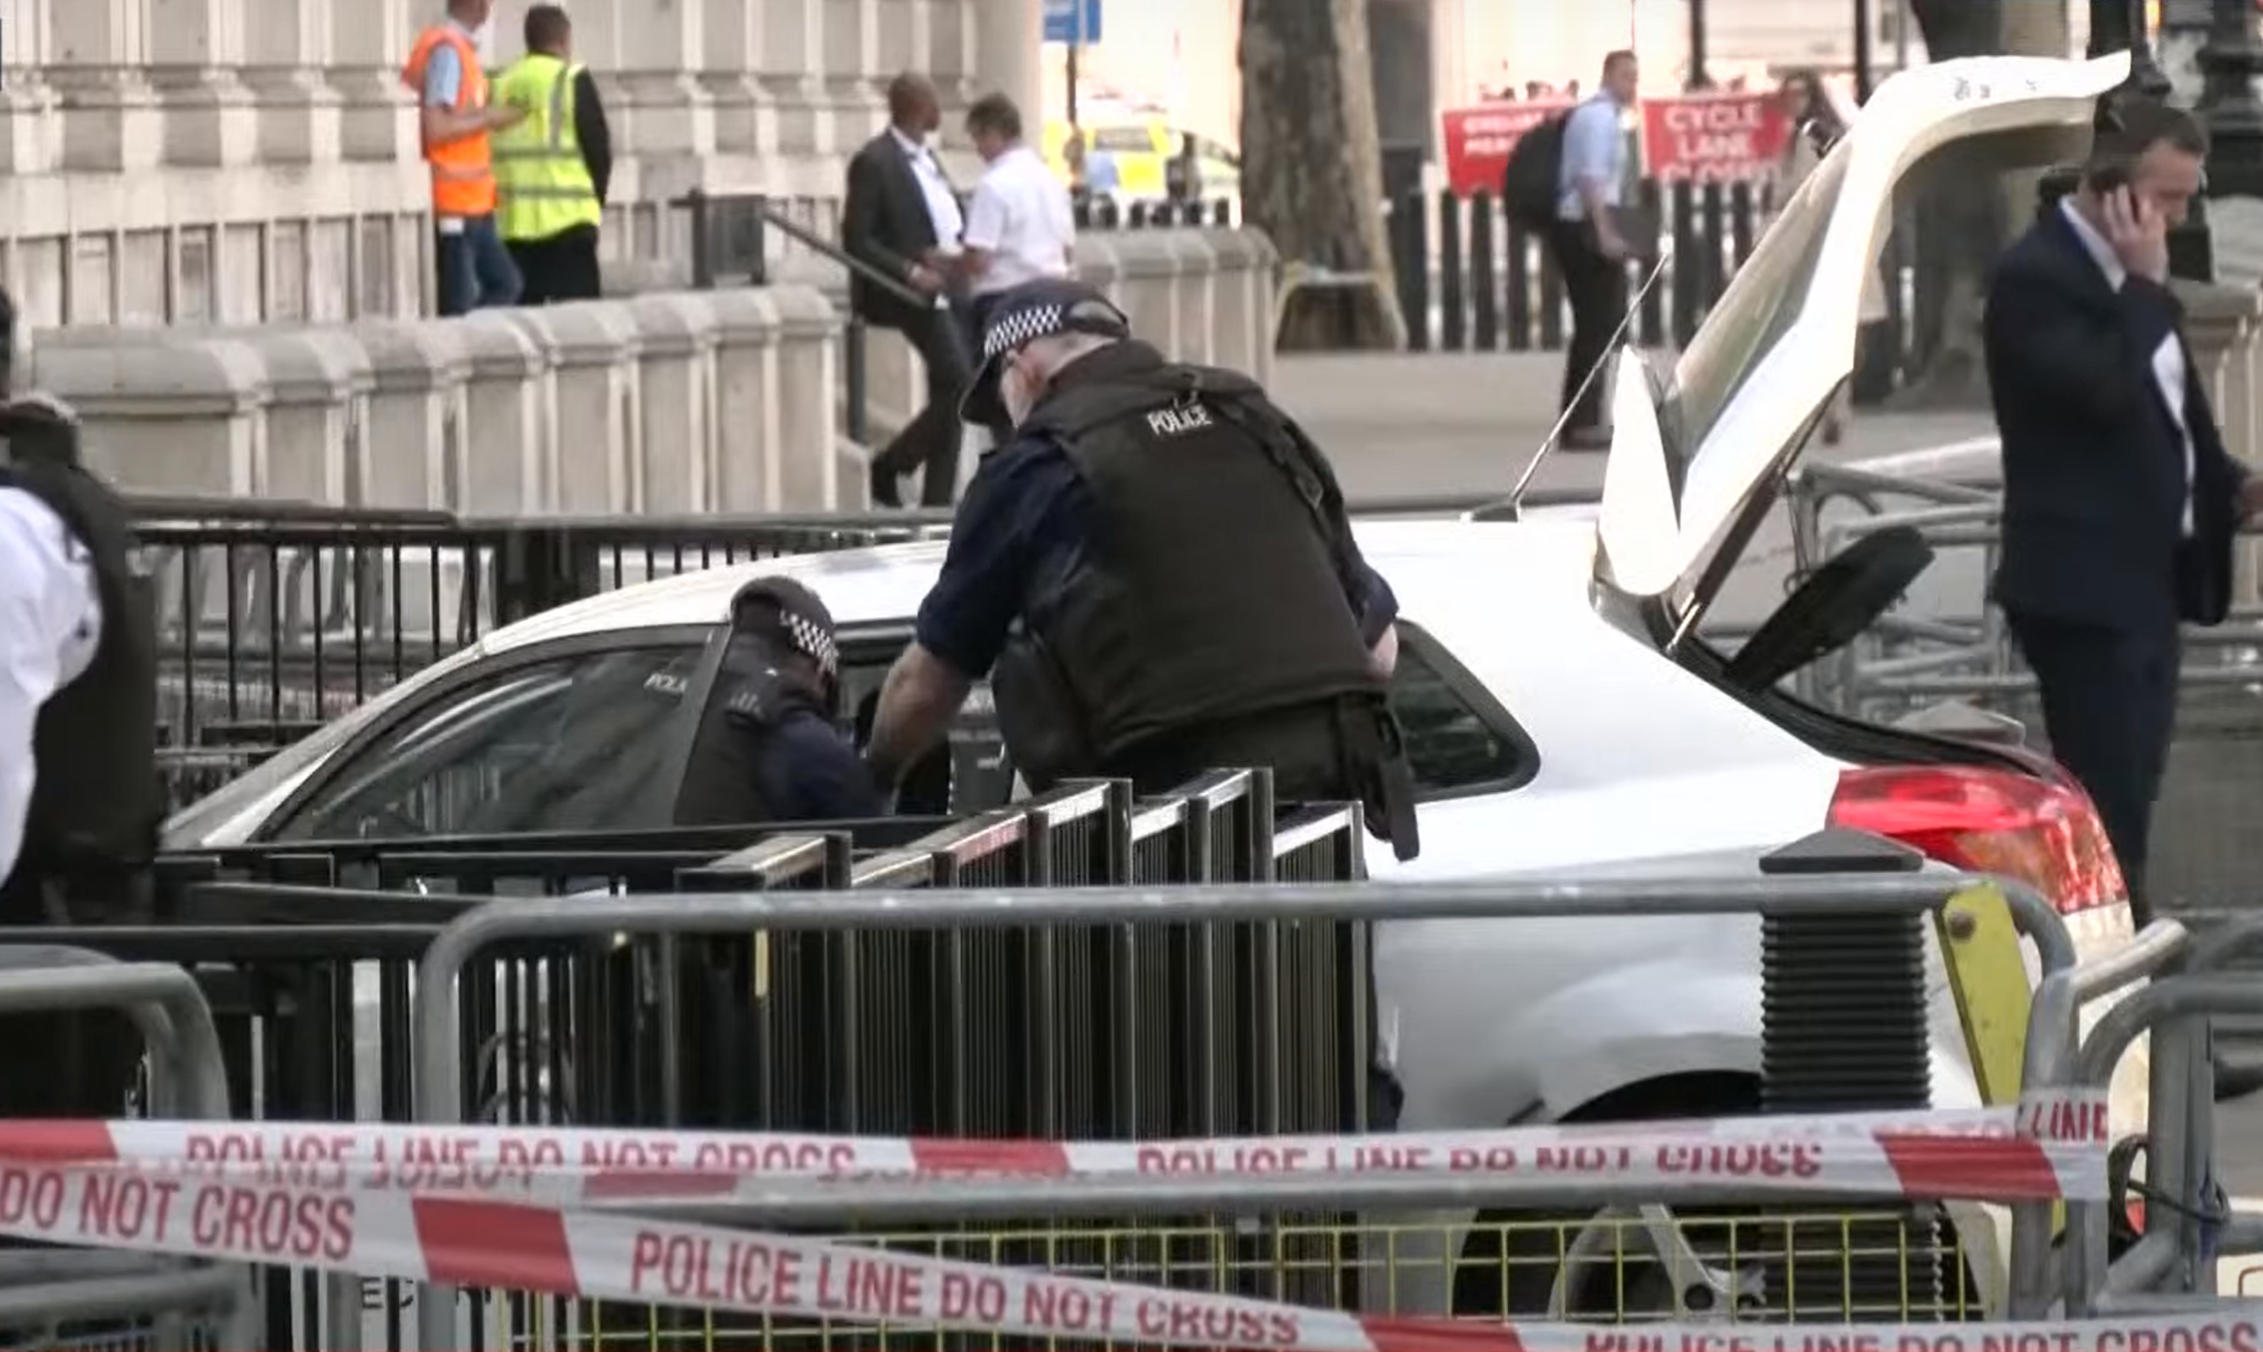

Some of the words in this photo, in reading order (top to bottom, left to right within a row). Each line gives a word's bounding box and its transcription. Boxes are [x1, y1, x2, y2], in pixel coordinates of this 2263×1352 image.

[1664, 103, 1763, 131] CYCLE
[1147, 405, 1213, 435] POLICE
[0, 1168, 65, 1231] DO
[77, 1174, 182, 1243] NOT
[191, 1184, 356, 1262] CROSS
[630, 1231, 802, 1306] POLICE
[817, 1254, 924, 1317] LINE
[940, 1272, 1006, 1324] DO
[1023, 1281, 1120, 1332] NOT
[1136, 1300, 1301, 1346] CROSS
